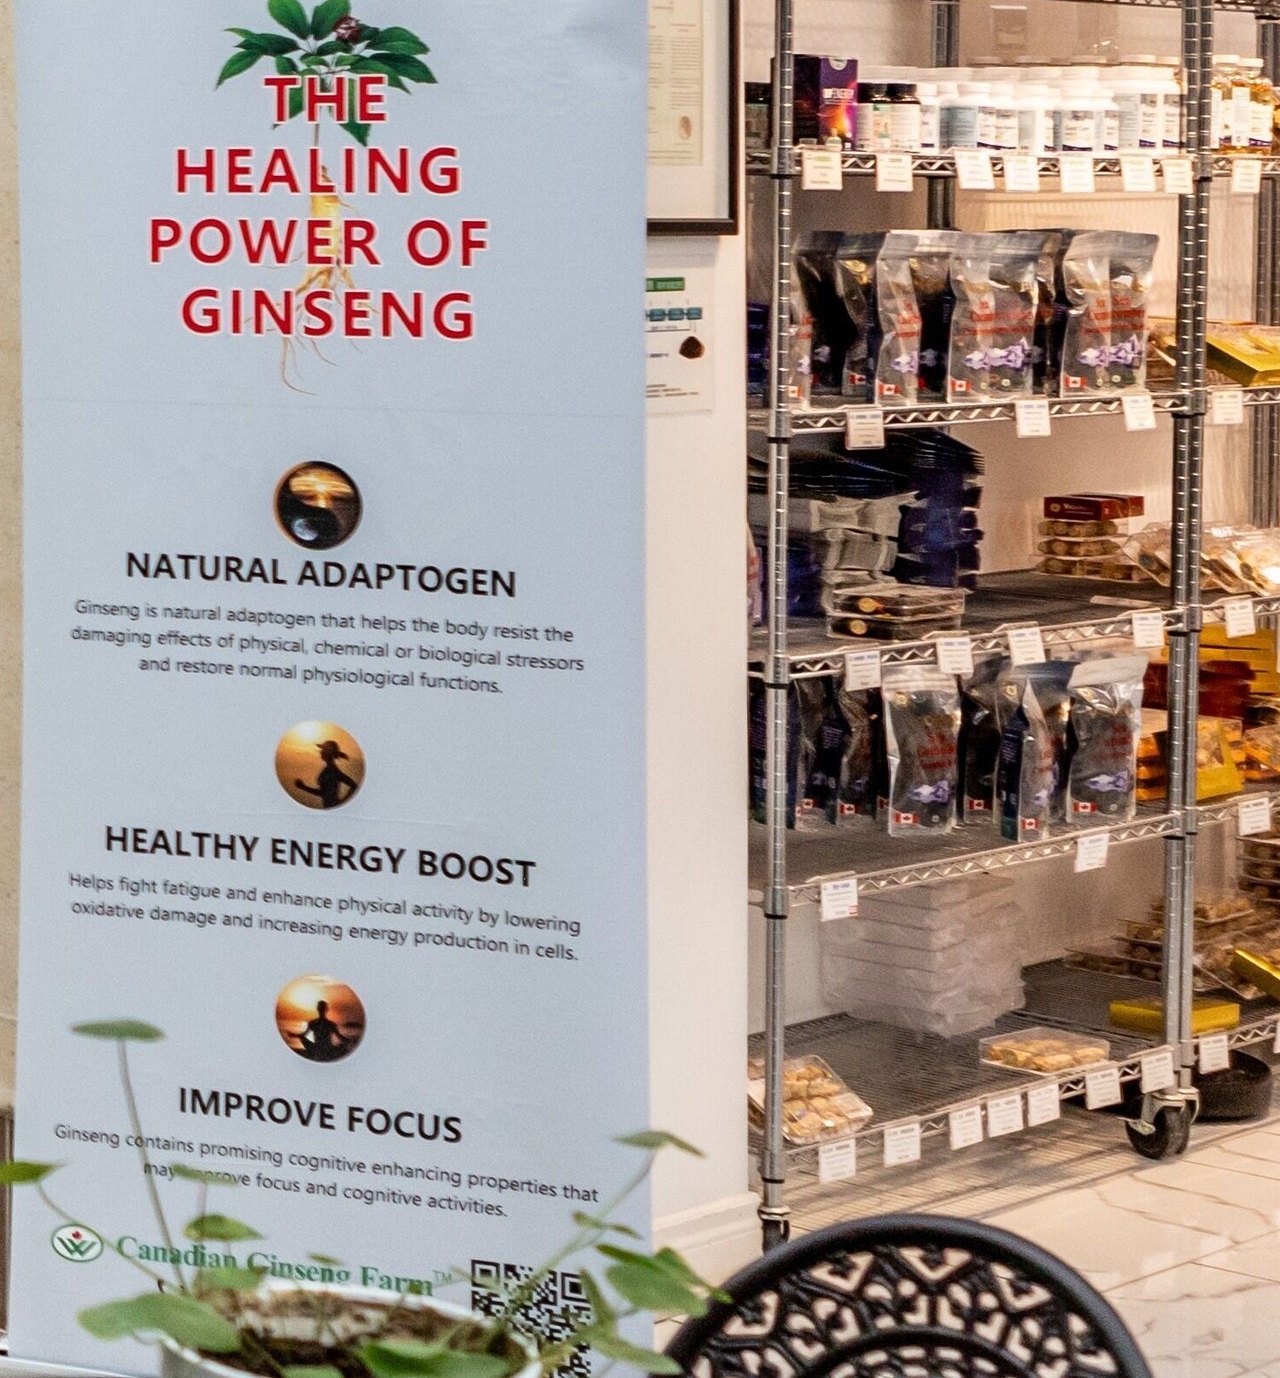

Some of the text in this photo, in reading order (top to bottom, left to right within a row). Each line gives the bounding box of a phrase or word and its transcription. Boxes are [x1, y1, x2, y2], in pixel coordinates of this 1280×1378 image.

[264, 74, 387, 123] THE
[175, 146, 460, 194] HEALING
[149, 218, 491, 268] POWER OF
[181, 288, 475, 340] GINSENG
[126, 552, 516, 597] NATURAL ADAPTOGEN
[75, 598, 574, 642] Ginseng is natural adaptogen that helps the body resist the
[70, 626, 585, 671] damaging effects of physical, chemical or biological stressors
[139, 657, 503, 693] and restore normal physiological functions.
[105, 825, 537, 887] HEALTHY ENERGY BOOST
[68, 872, 581, 937] Helps fight fatigue and enhance physical activity by lowering
[71, 900, 579, 960] oxidative damage and increasing energy production in cells.
[179, 1087, 462, 1143] IMPROVE FOCUS
[55, 1124, 599, 1203] Ginseng contains promising cognitive enhancing properties that
[144, 1163, 175, 1182] may
[256, 1173, 301, 1194] focus
[306, 1181, 337, 1198] and
[343, 1183, 422, 1207] cognitive
[427, 1194, 508, 1218] activities.
[116, 1235, 238, 1272] Canadian
[360, 1265, 433, 1297] Farm
